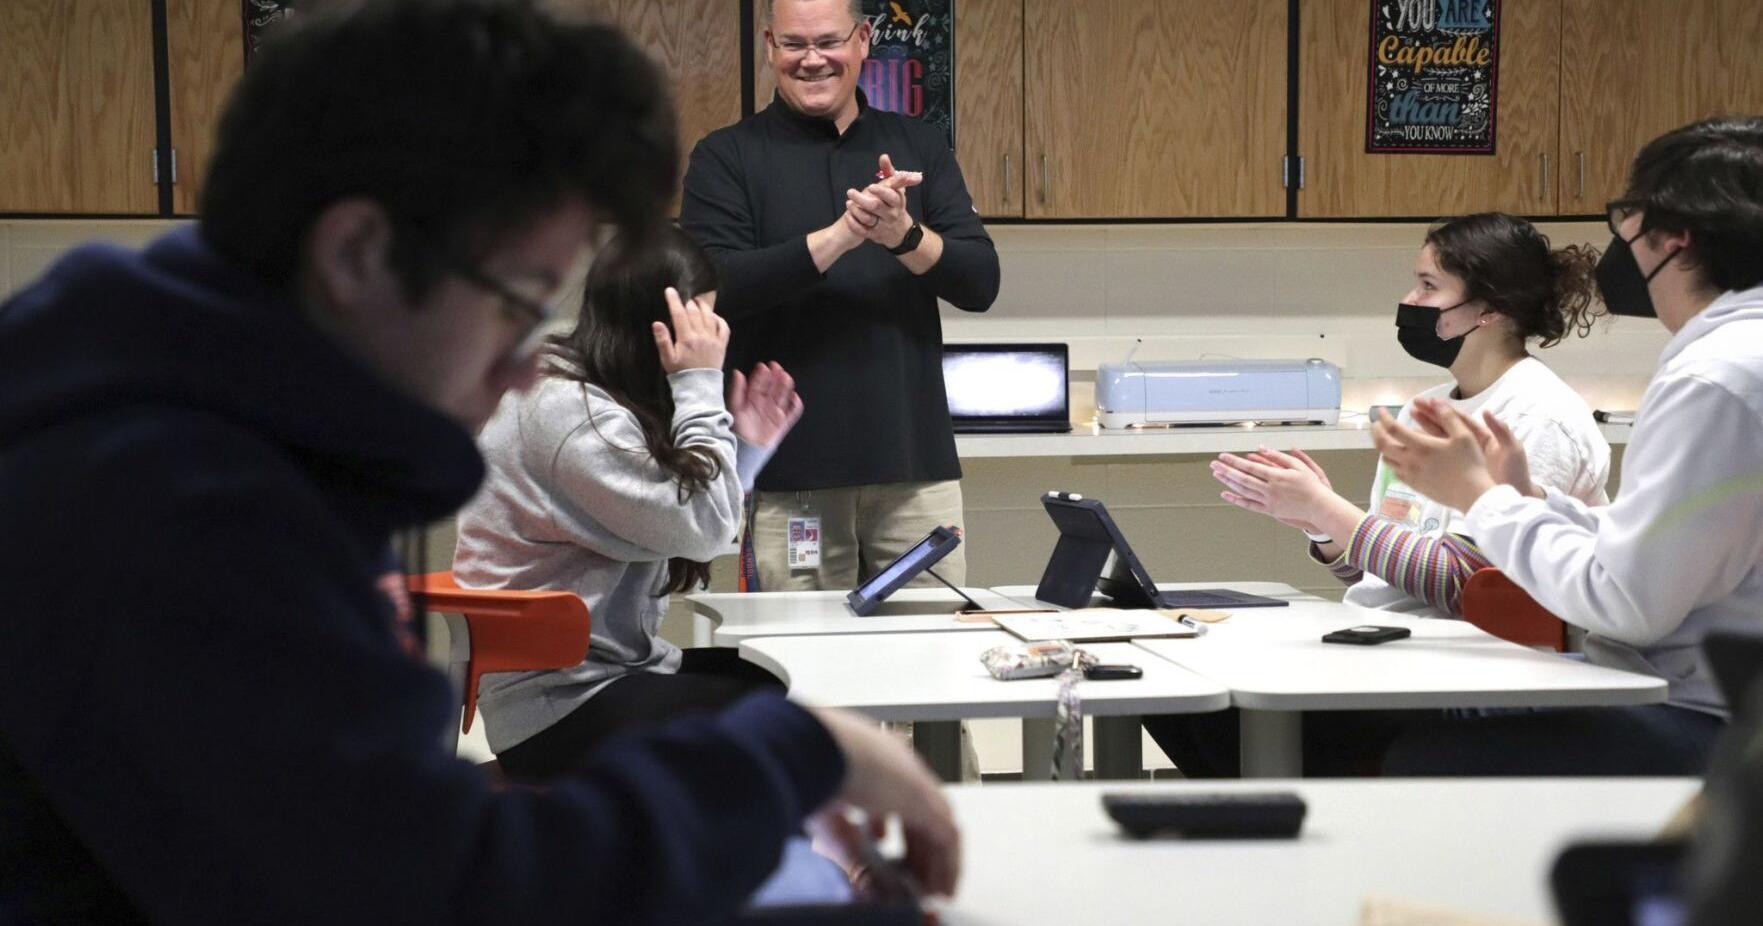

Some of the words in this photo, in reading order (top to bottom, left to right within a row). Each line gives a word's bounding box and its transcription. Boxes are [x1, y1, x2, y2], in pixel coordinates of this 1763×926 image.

[1396, 0, 1435, 31] YOU
[1444, 0, 1480, 24] ARE
[1378, 34, 1491, 75] Capable
[1423, 83, 1436, 93] OF
[1437, 83, 1460, 93] MORE
[1390, 90, 1461, 125] than
[1404, 125, 1424, 140] YOU
[1425, 125, 1454, 141] KNOW
